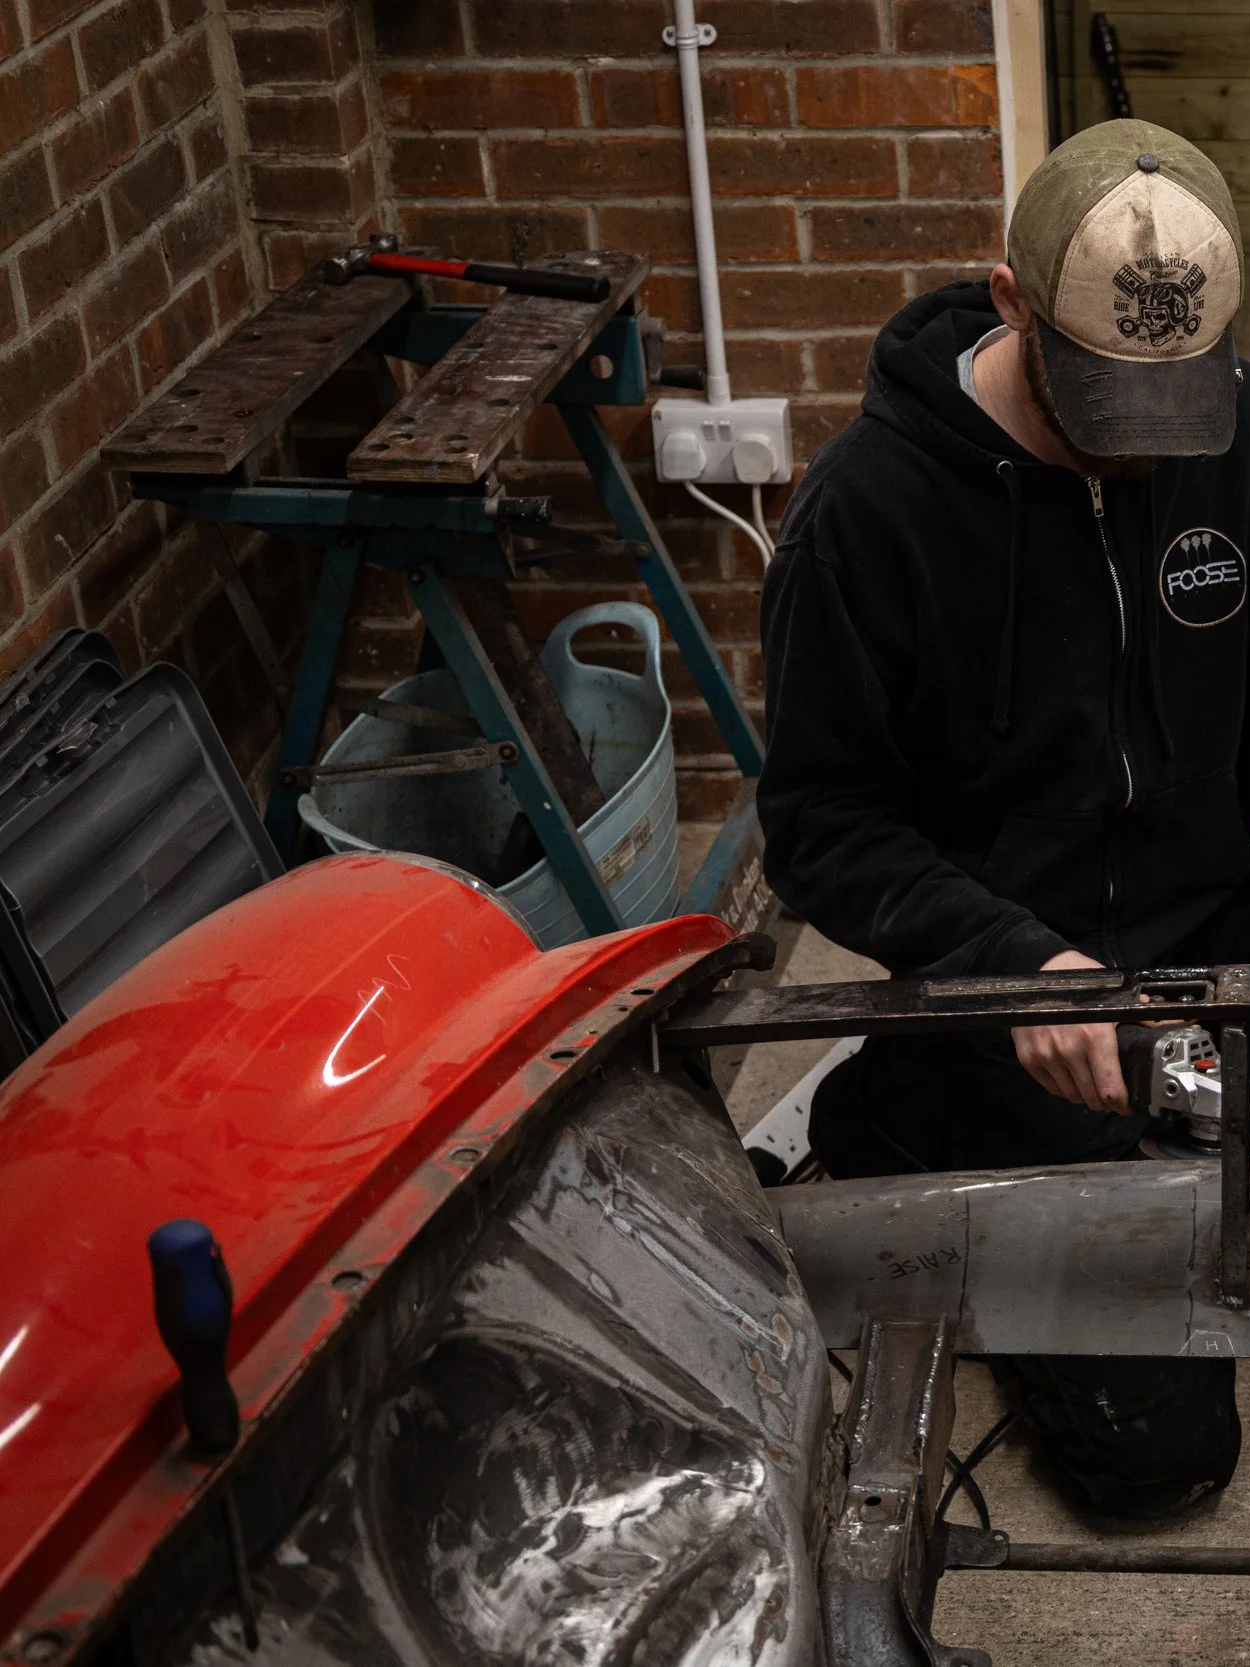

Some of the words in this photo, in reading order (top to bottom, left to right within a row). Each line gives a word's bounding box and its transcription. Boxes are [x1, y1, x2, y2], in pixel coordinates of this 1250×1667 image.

[1138, 345, 1183, 356] CALIFORNIA
[1166, 559, 1240, 596] FOOSE
[888, 1246, 962, 1280] RAISE
